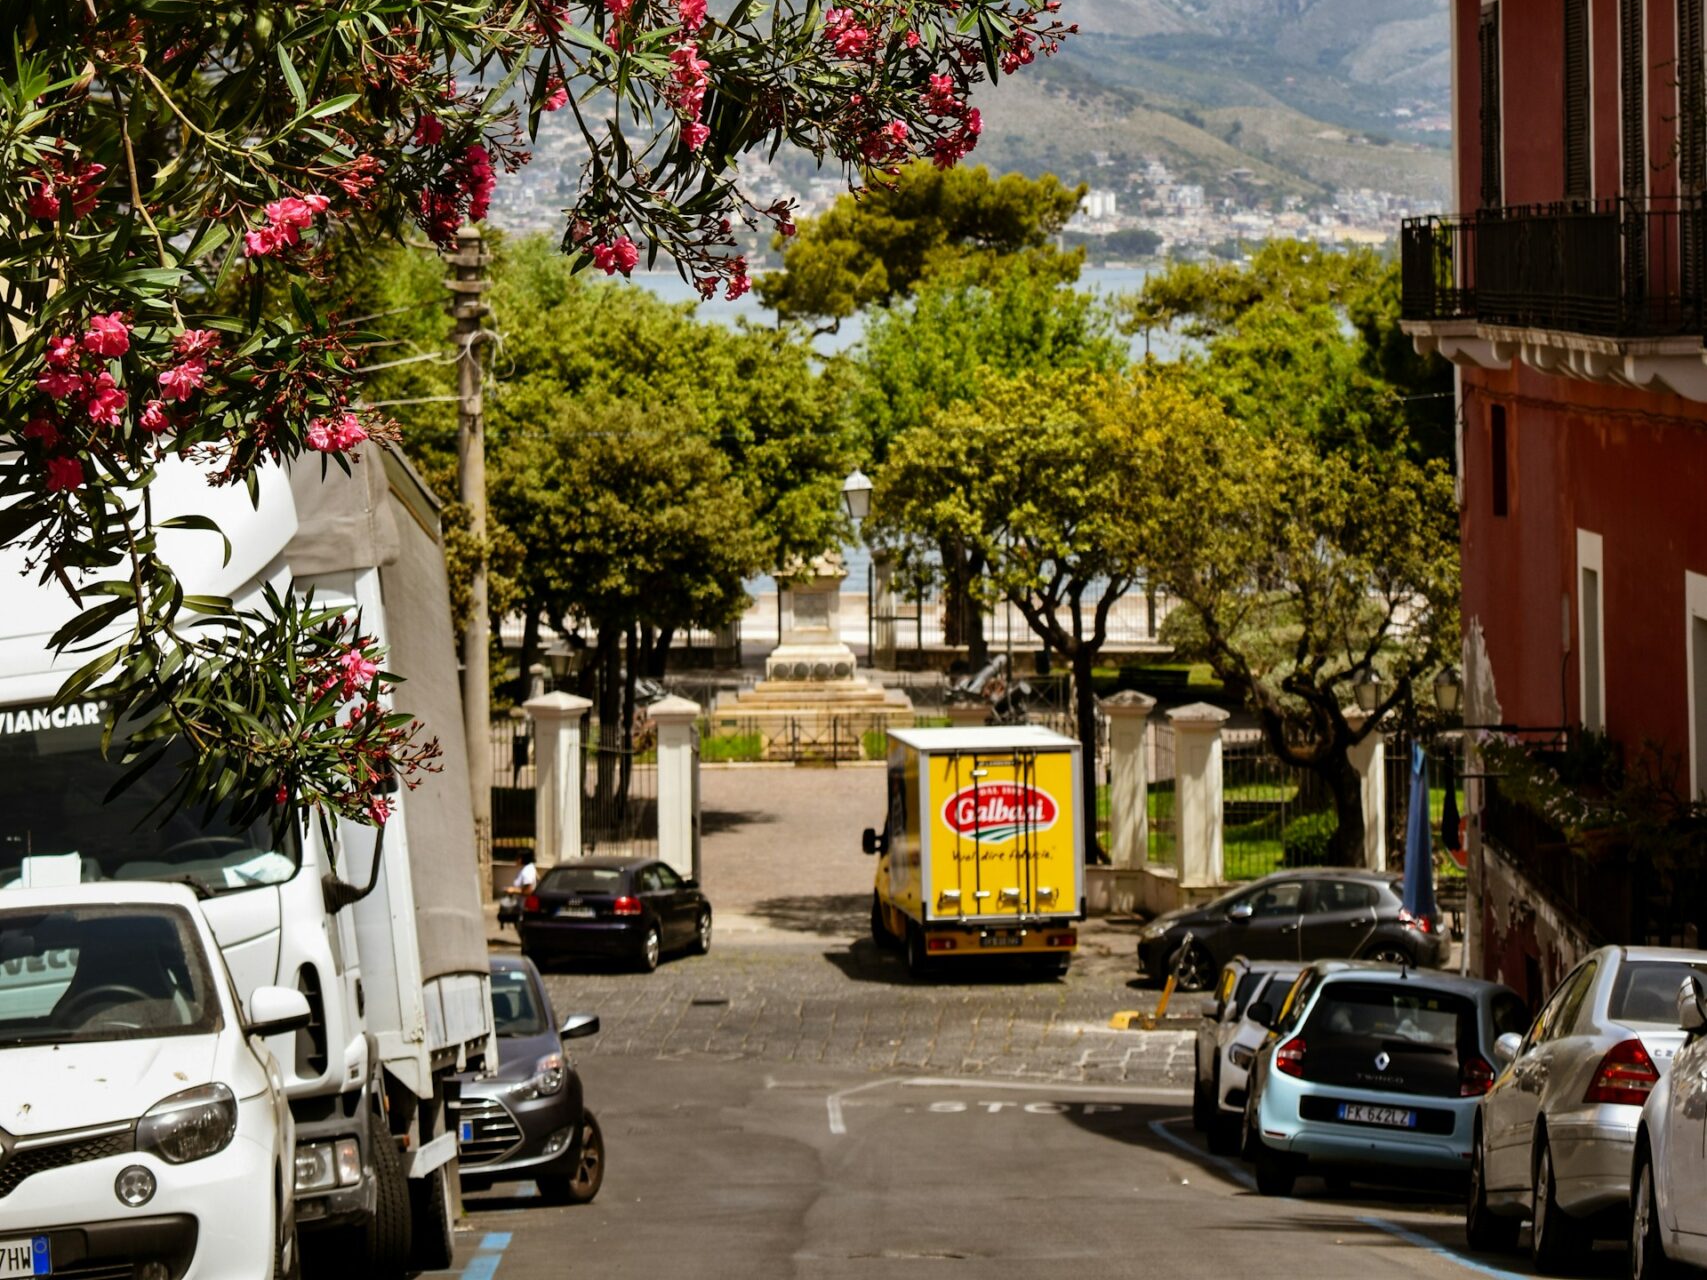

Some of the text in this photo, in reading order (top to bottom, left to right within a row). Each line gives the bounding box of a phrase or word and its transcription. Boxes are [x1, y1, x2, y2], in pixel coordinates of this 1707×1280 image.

[955, 797, 1045, 825] Galbani
[981, 850, 1004, 861] dire
[928, 1101, 1123, 1114] STOP
